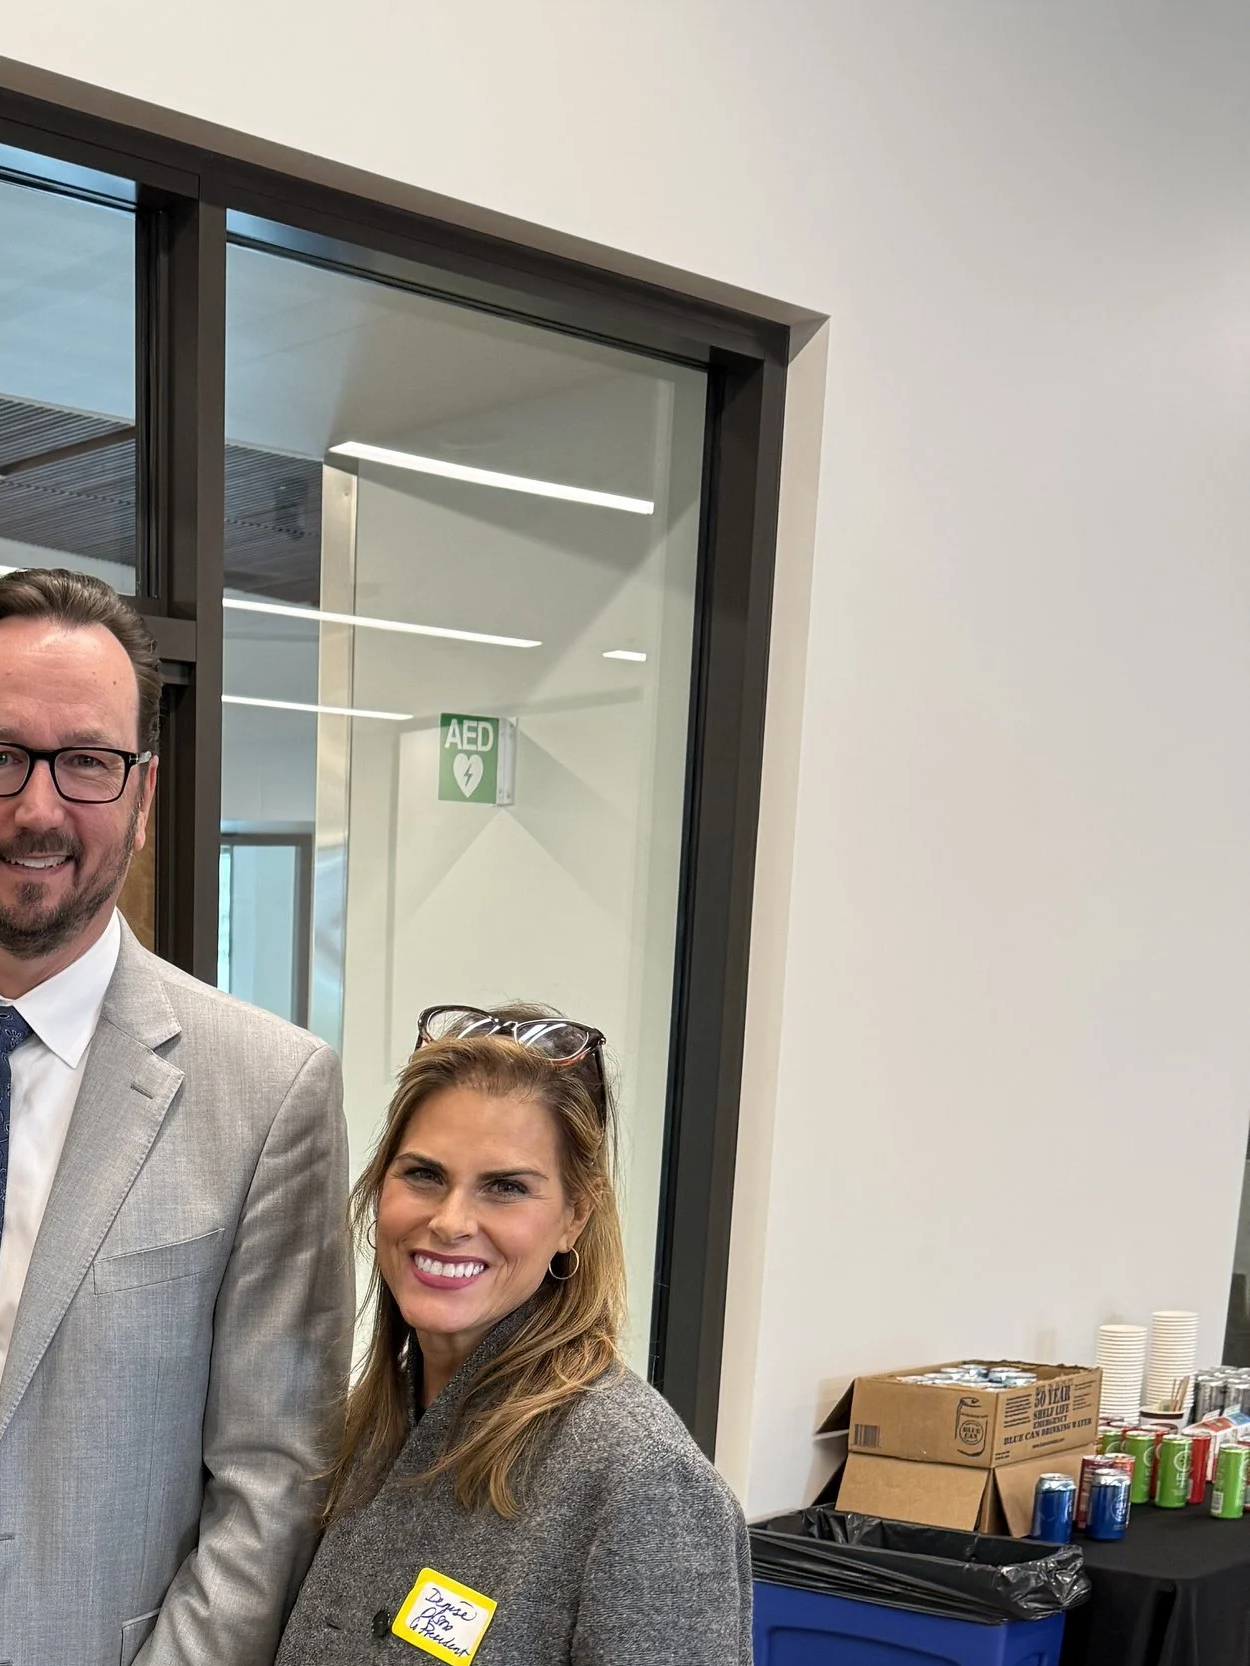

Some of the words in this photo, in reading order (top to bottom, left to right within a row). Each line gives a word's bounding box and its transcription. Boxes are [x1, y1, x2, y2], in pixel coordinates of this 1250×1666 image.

[444, 718, 494, 752] AED
[1048, 1385, 1071, 1406] YEAR
[1033, 1407, 1054, 1420] SHELF
[1055, 1404, 1070, 1416] LIFE
[1003, 1436, 1023, 1446] BLUE
[1025, 1430, 1040, 1441] CAN
[1041, 1422, 1071, 1437] DRINKING
[1072, 1417, 1092, 1429] WATER
[425, 1588, 477, 1622] Denise
